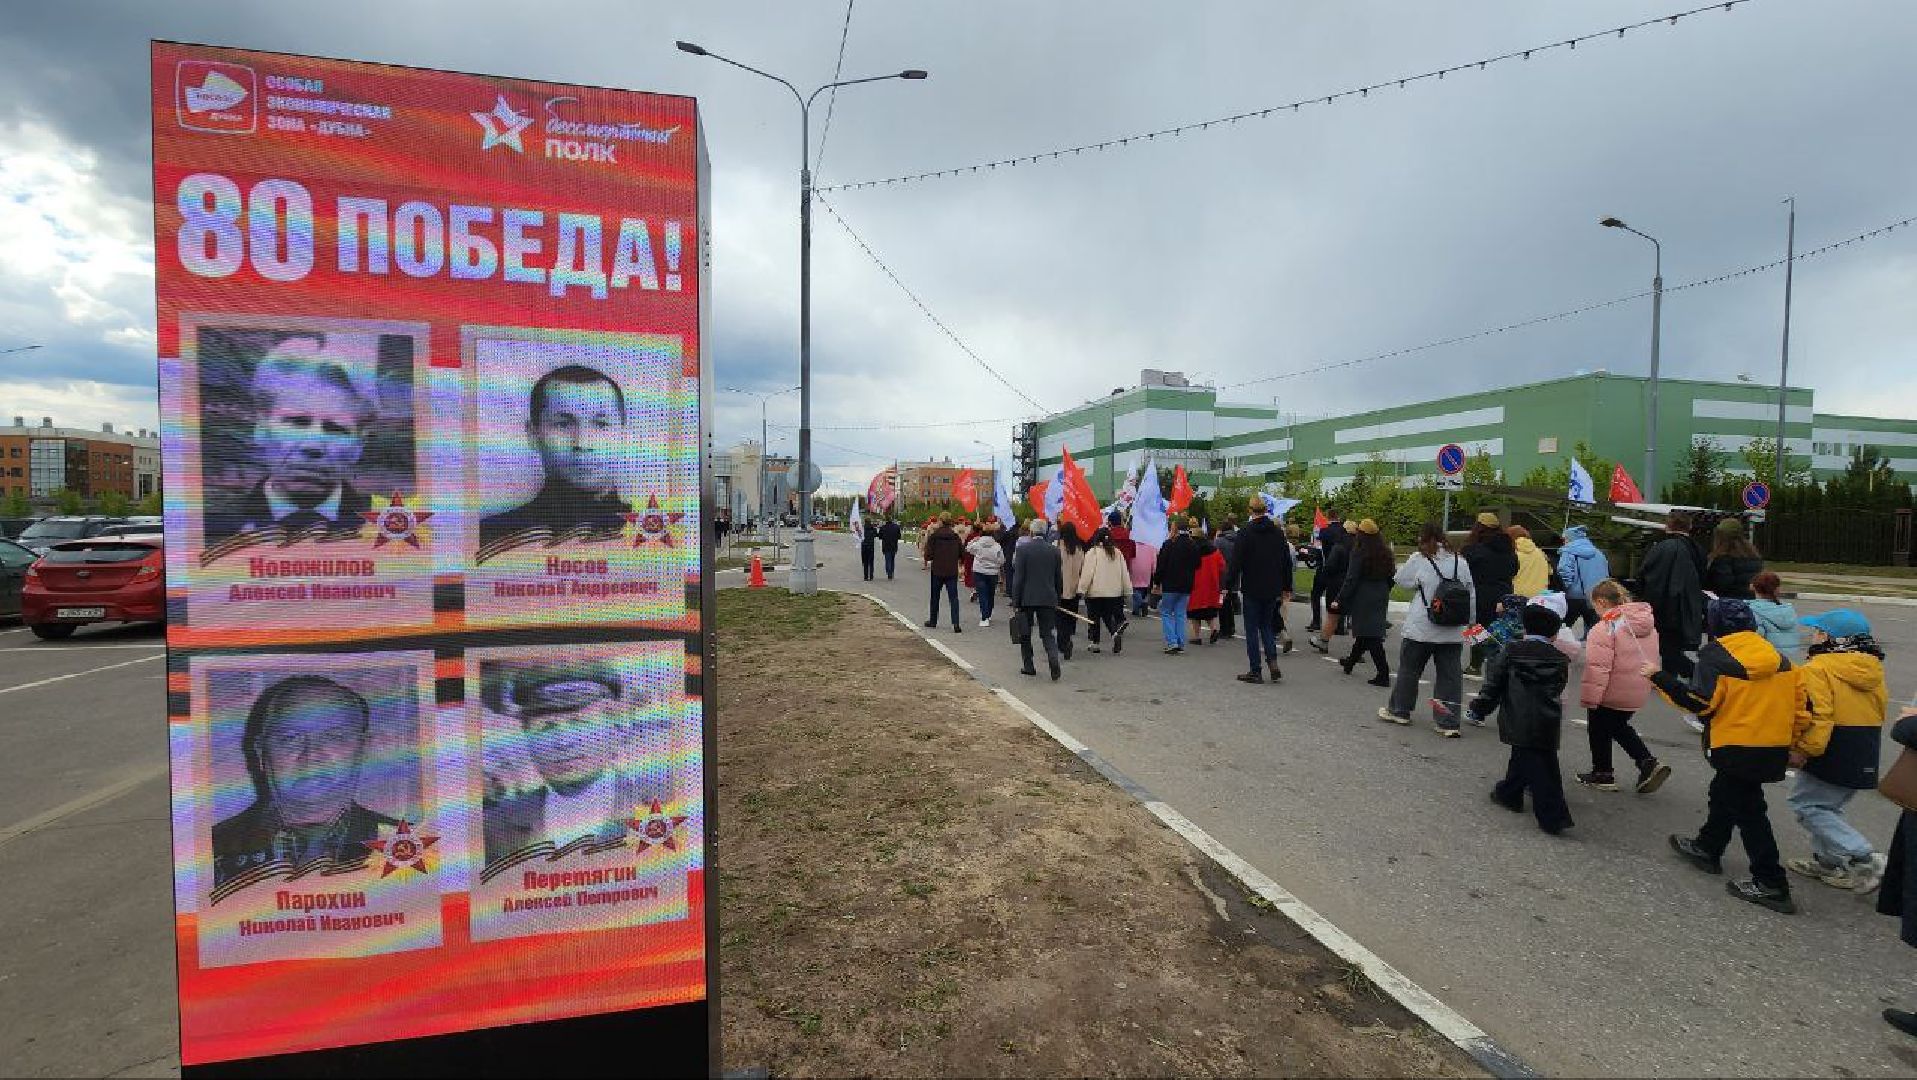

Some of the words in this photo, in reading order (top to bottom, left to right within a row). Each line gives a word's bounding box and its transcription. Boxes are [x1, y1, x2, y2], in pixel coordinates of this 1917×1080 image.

[267, 115, 306, 131] ЗОНА
[546, 139, 618, 163] ПОЛК
[177, 172, 315, 281] 80
[336, 195, 682, 299] ПОБЕДА!
[250, 557, 375, 577] Новожилов
[546, 556, 608, 575] Носов
[229, 583, 306, 602] Алексей
[312, 583, 396, 600] Иванович
[495, 578, 566, 597] Николай
[571, 580, 658, 600] Андреевич
[523, 867, 637, 891] Перетягин
[275, 890, 366, 913] Парохин
[503, 893, 571, 913] Алексей
[577, 886, 659, 906] Петрович
[239, 915, 316, 936] Николай
[320, 912, 405, 931] Иванович
